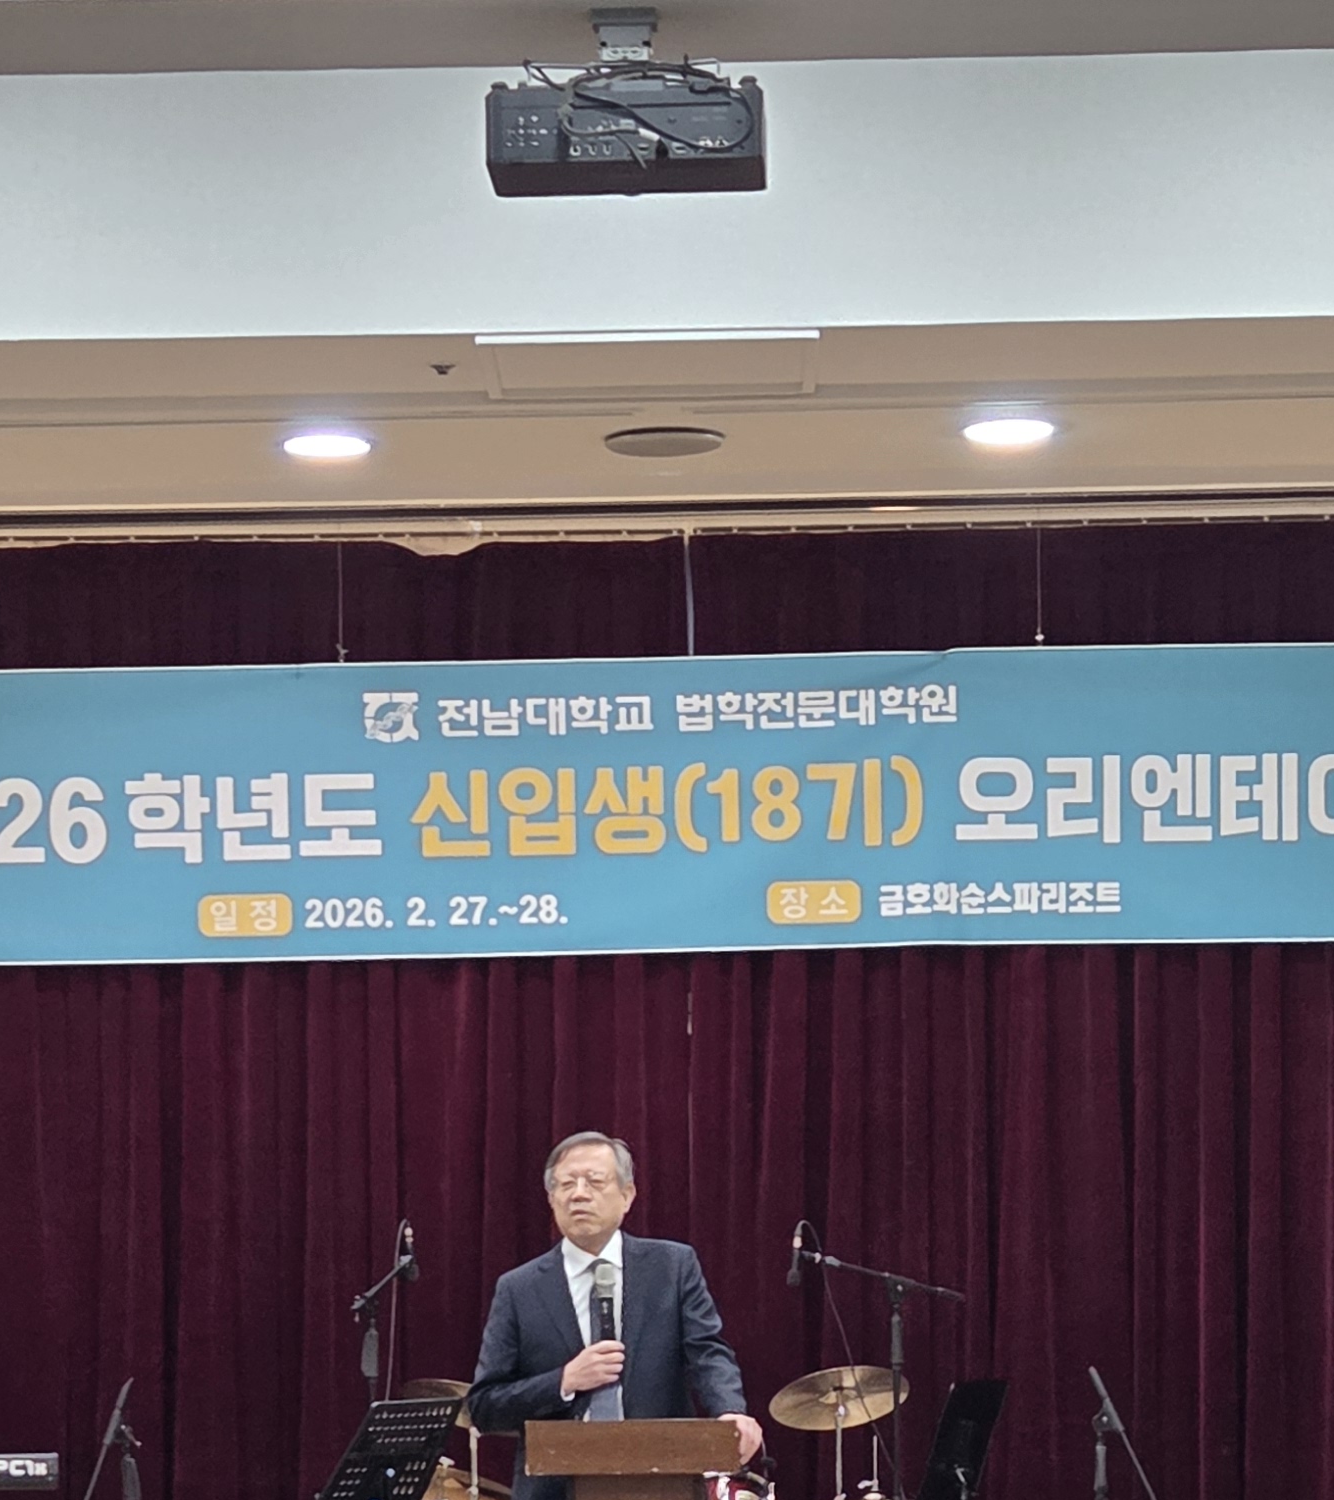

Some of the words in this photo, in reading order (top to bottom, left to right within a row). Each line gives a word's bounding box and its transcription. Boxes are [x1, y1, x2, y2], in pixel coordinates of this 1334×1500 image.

[437, 694, 654, 738] 전남대학교
[675, 684, 959, 733] 법학전문대학원
[410, 754, 925, 859] 신입생(18기)
[304, 897, 394, 929] 2026.
[406, 896, 437, 928] 2.
[448, 894, 569, 926] 27.~28.
[878, 881, 1122, 917] 금호화순스파리조트
